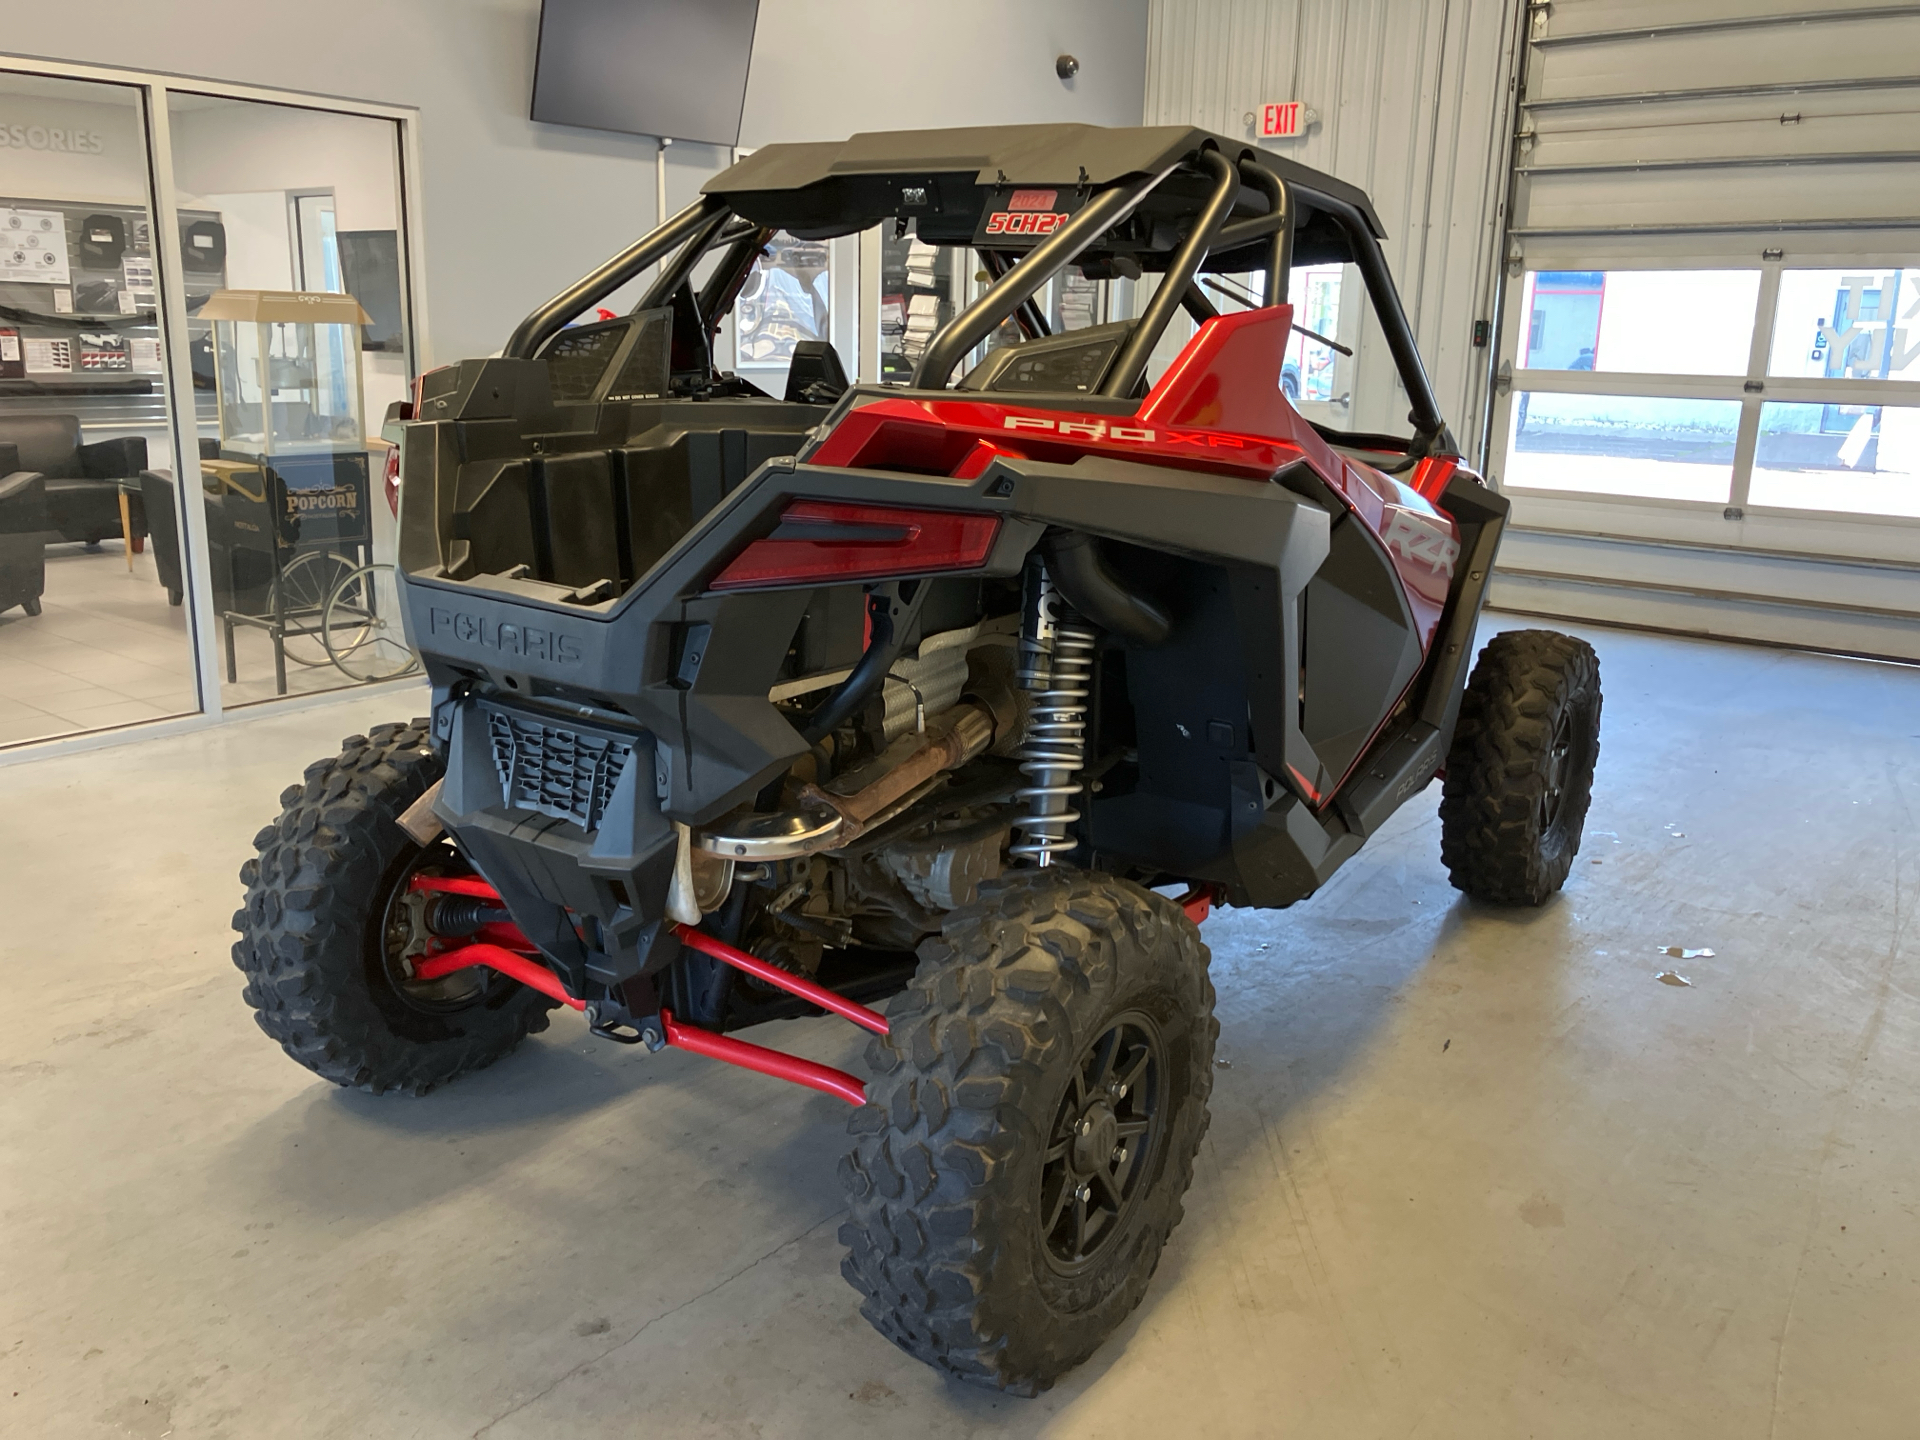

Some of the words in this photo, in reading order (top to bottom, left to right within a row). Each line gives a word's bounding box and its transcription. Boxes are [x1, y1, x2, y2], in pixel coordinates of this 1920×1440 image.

[1263, 104, 1299, 135] EXIT
[1011, 194, 1048, 208] 2024
[1003, 415, 1155, 442] PRO
[1165, 431, 1244, 448] XP
[286, 492, 357, 513] POPCORN
[1383, 509, 1461, 580] RZR
[430, 607, 583, 663] POLARIS
[1396, 748, 1438, 801] POLARIS
